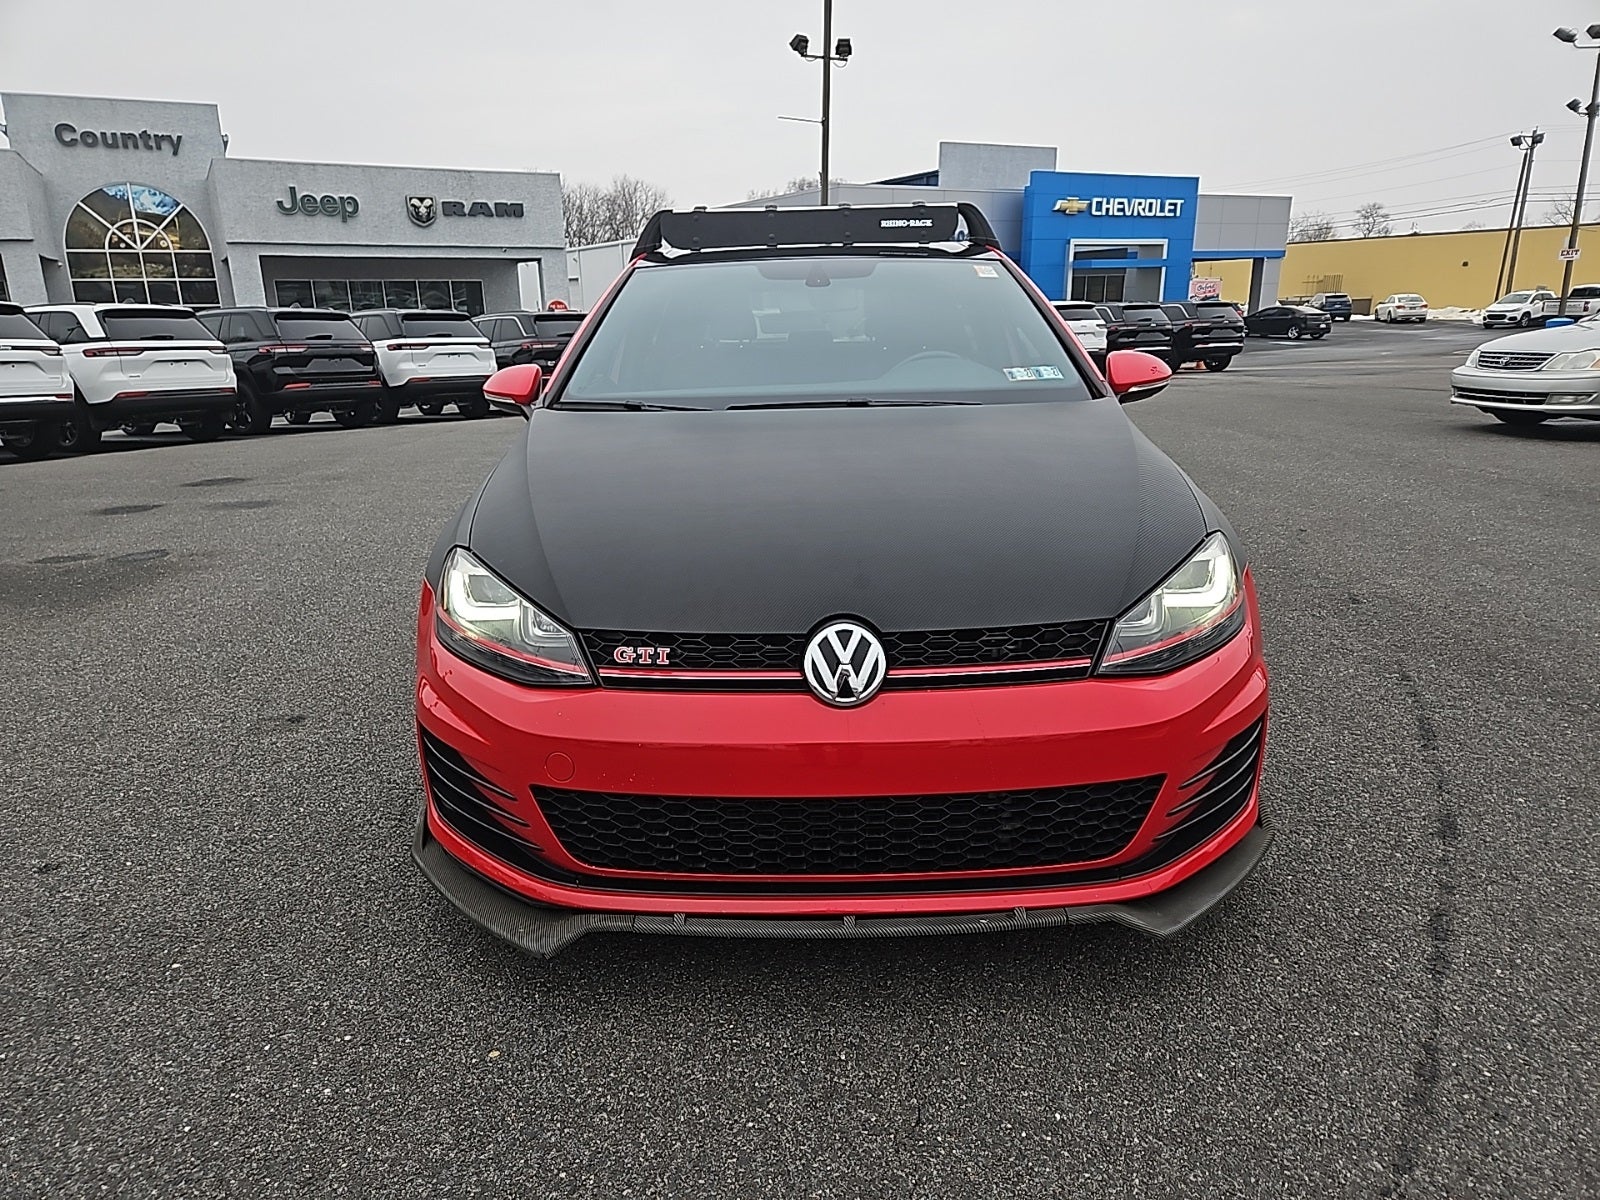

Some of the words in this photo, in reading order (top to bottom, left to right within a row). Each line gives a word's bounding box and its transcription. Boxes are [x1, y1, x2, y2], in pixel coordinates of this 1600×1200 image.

[54, 122, 183, 157] Country
[276, 185, 360, 223] Jeep
[441, 200, 525, 218] RAM
[1091, 197, 1185, 217] CHEVROLET
[880, 219, 933, 228] RHINO-RACK
[1560, 248, 1580, 257] EXIT
[613, 646, 670, 664] GTI
